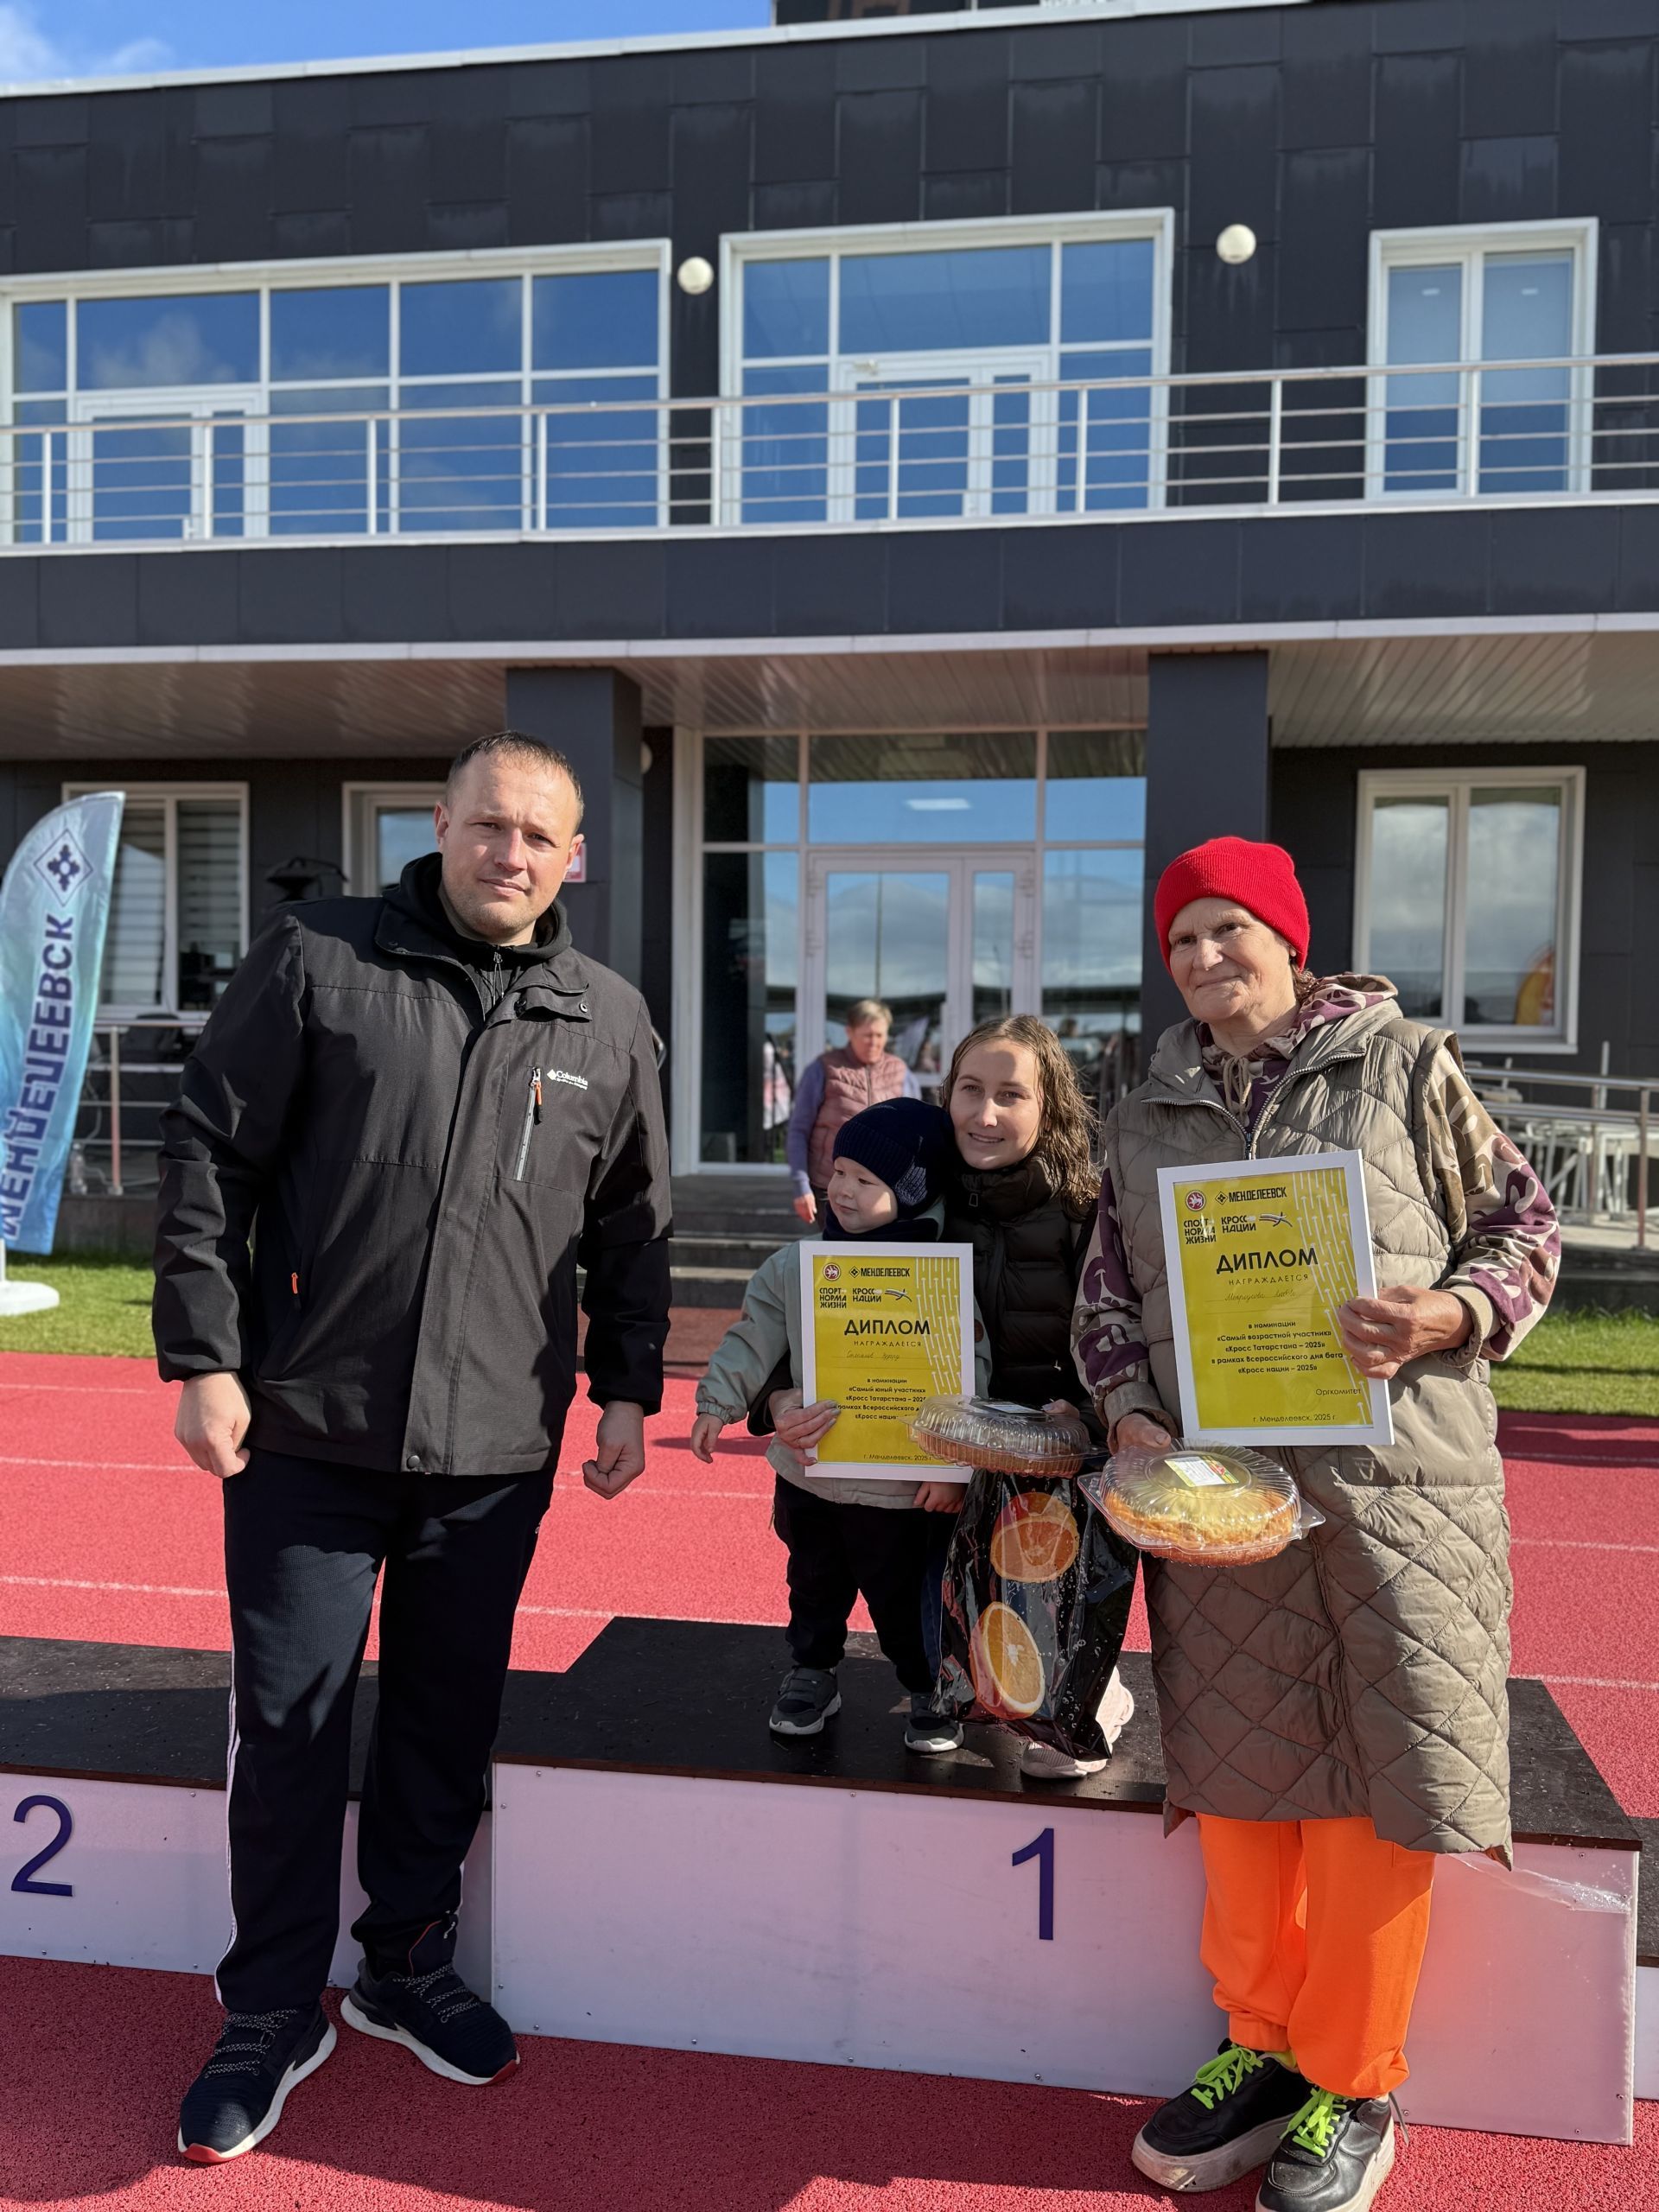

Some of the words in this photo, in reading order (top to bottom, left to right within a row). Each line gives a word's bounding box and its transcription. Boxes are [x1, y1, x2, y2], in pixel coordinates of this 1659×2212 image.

[556, 1071, 588, 1086] Columbia
[1229, 1187, 1287, 1203] МЕНДЕЛЕЕВСК
[1221, 1215, 1248, 1224] КРОСС
[1222, 1224, 1256, 1234] НАЦИИ
[1185, 1235, 1217, 1244] ЖИЗНИ
[1217, 1248, 1319, 1274] ДИПЛОМ
[861, 1268, 910, 1277] МЕНДЕЛЕЕВСК
[1229, 1274, 1308, 1286] НАГРАЖДАЕТСЯ
[844, 1319, 931, 1336] ДИПЛОМ
[1225, 1344, 1251, 1352] «Кросс
[1253, 1343, 1298, 1351] Татарстана
[1246, 1354, 1308, 1363] Всероссийского
[10, 1795, 73, 1897] 2
[1012, 1827, 1054, 1941] 1
